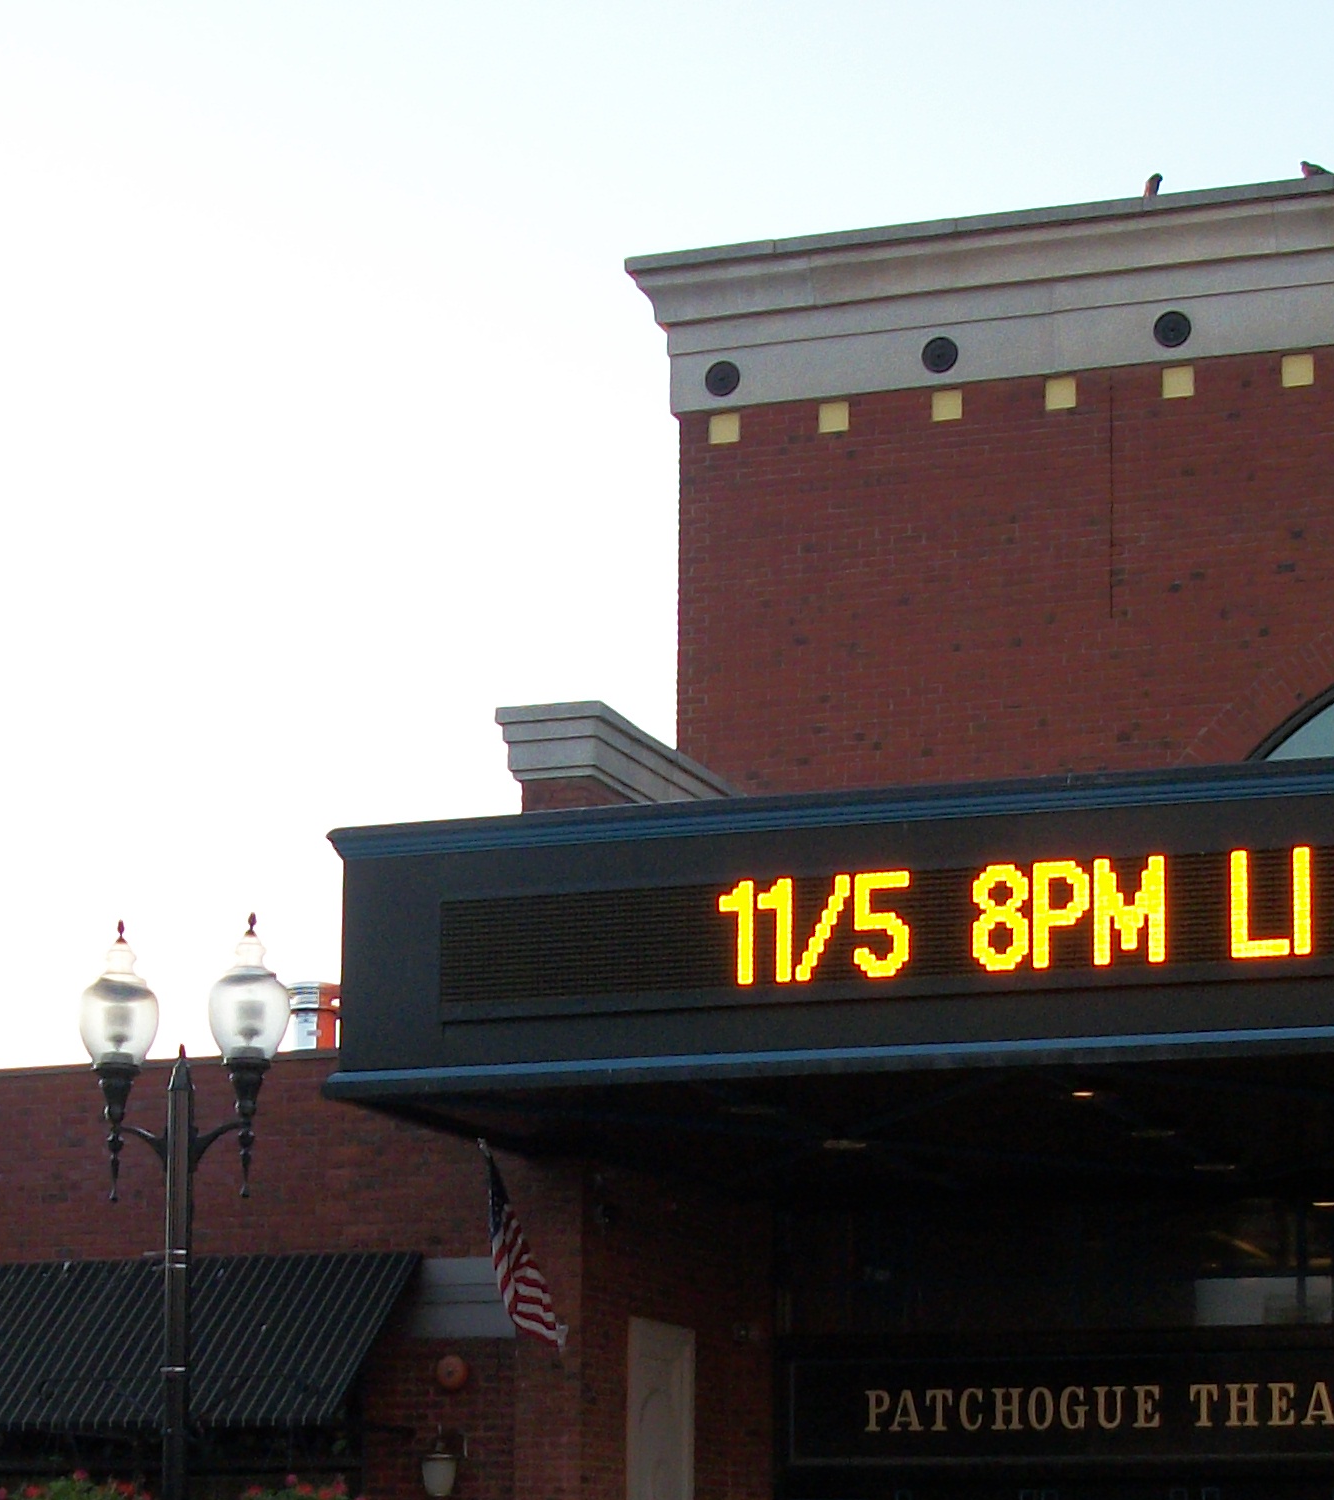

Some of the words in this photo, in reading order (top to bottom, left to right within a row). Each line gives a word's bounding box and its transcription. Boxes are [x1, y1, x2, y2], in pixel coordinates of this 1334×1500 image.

[717, 869, 912, 988] 11/5
[970, 853, 1168, 974] 8PM
[1228, 844, 1314, 961] LI
[863, 1384, 1162, 1432] PATCHOGUE
